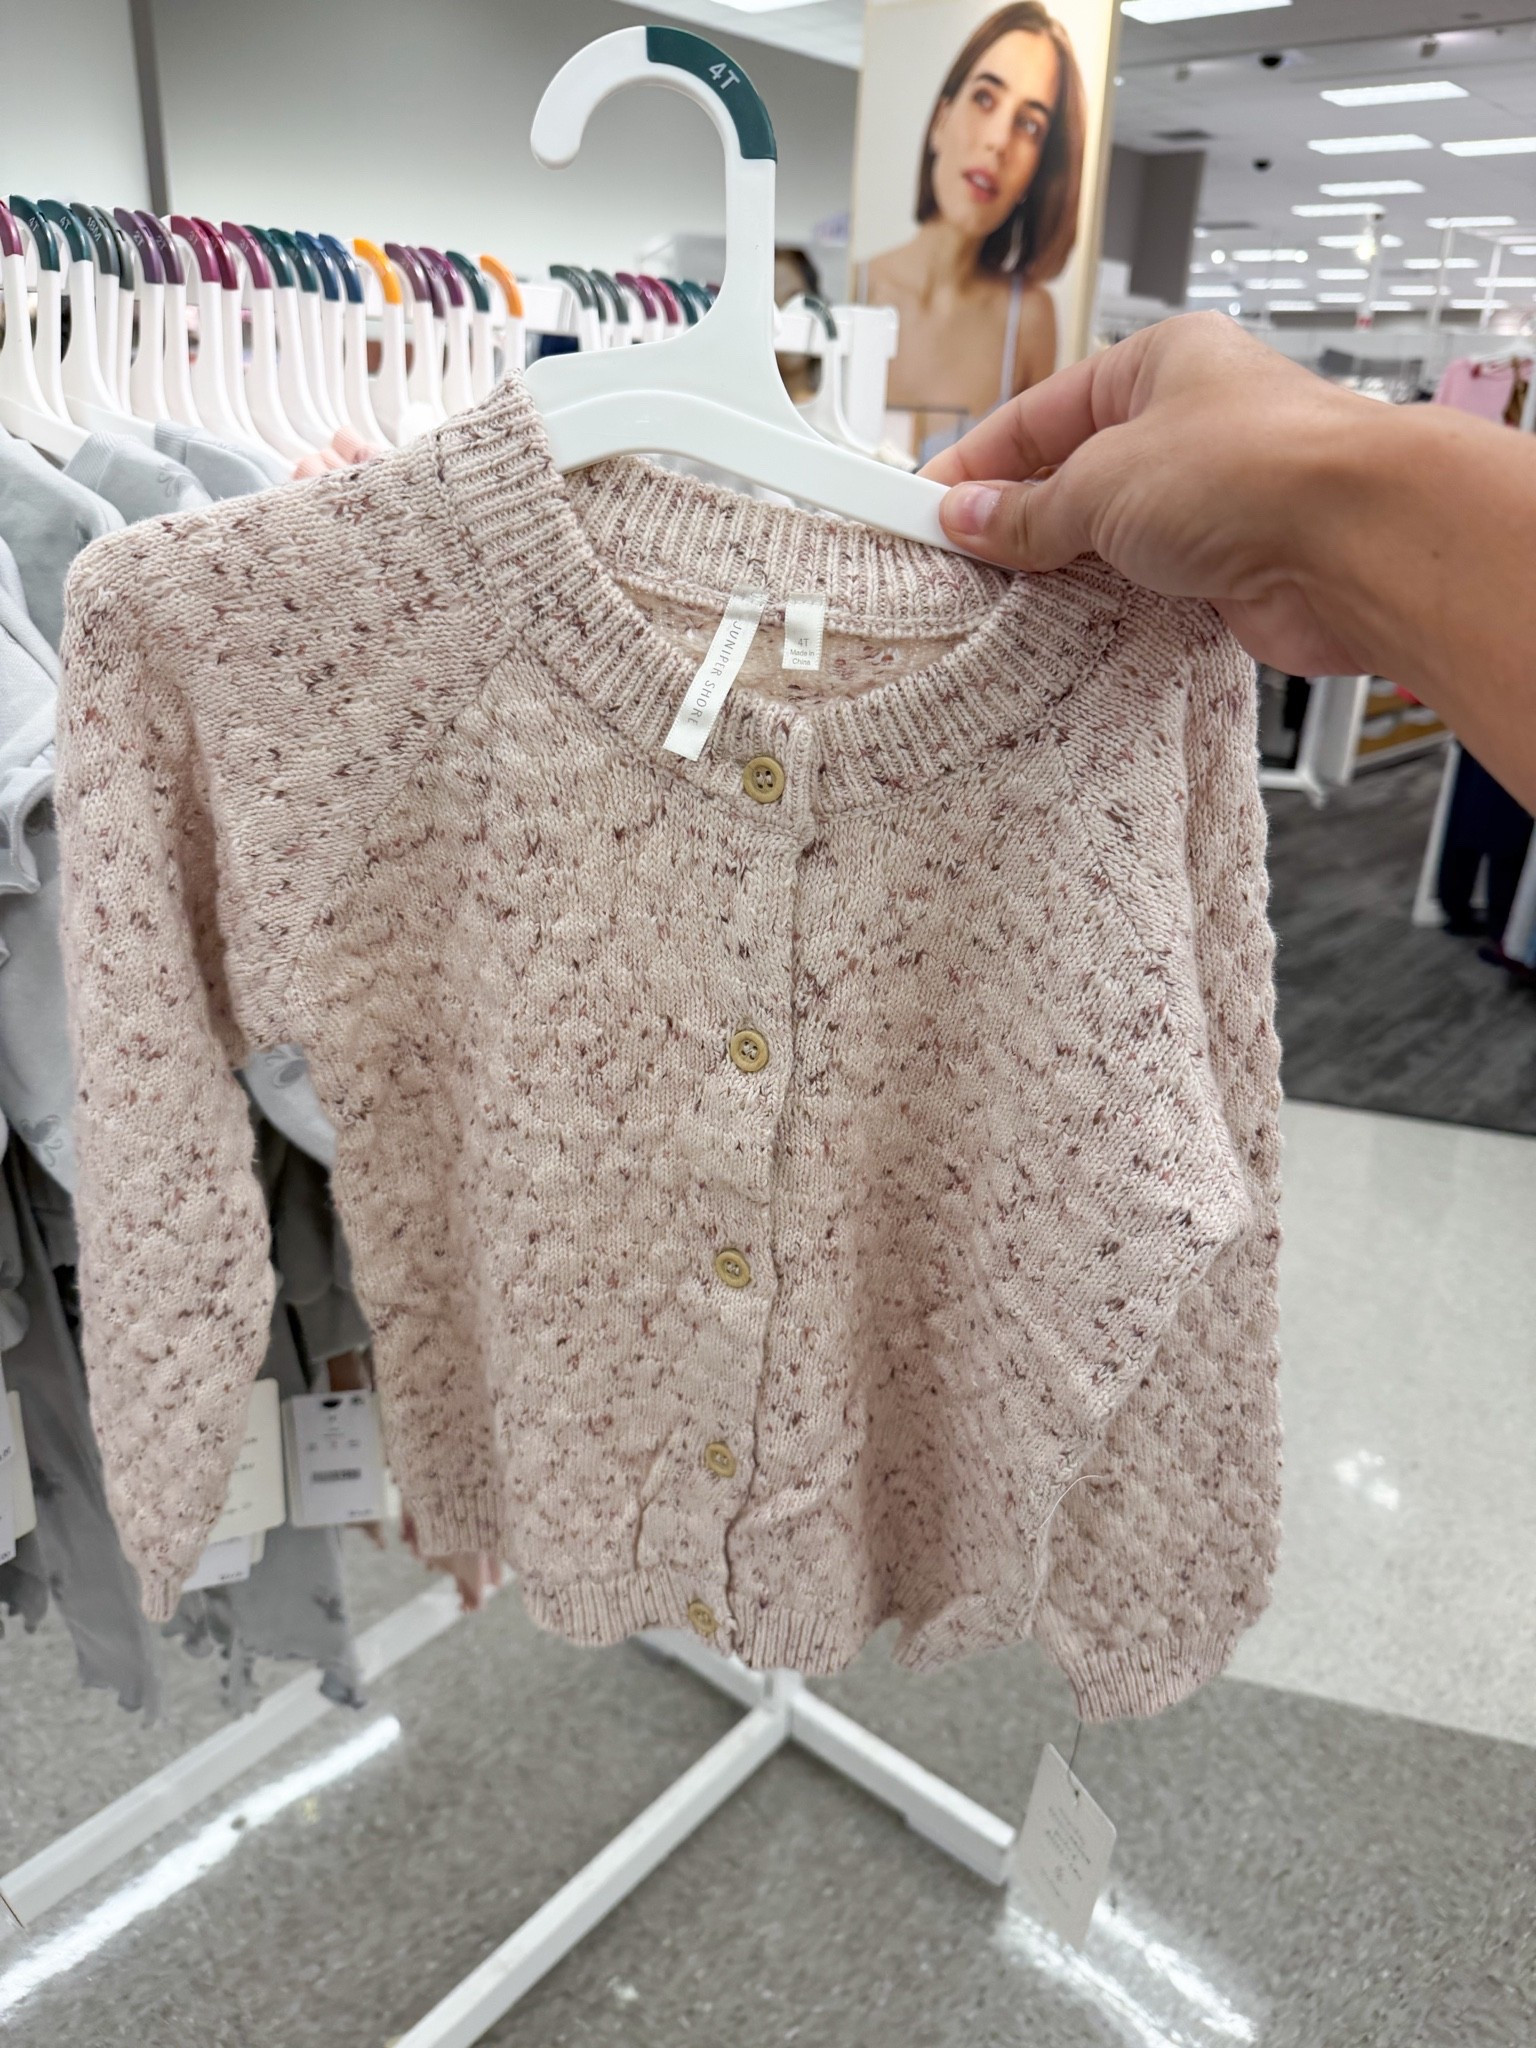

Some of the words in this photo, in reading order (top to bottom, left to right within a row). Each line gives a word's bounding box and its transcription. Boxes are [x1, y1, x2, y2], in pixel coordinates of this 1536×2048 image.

[708, 63, 741, 90] 4T
[28, 216, 40, 232] 4T
[60, 216, 72, 230] 4T
[86, 216, 102, 242] 18M
[711, 620, 742, 677] JUNIPER
[798, 638, 809, 647] 4T
[792, 657, 811, 665] China
[688, 680, 715, 726] SHORE
